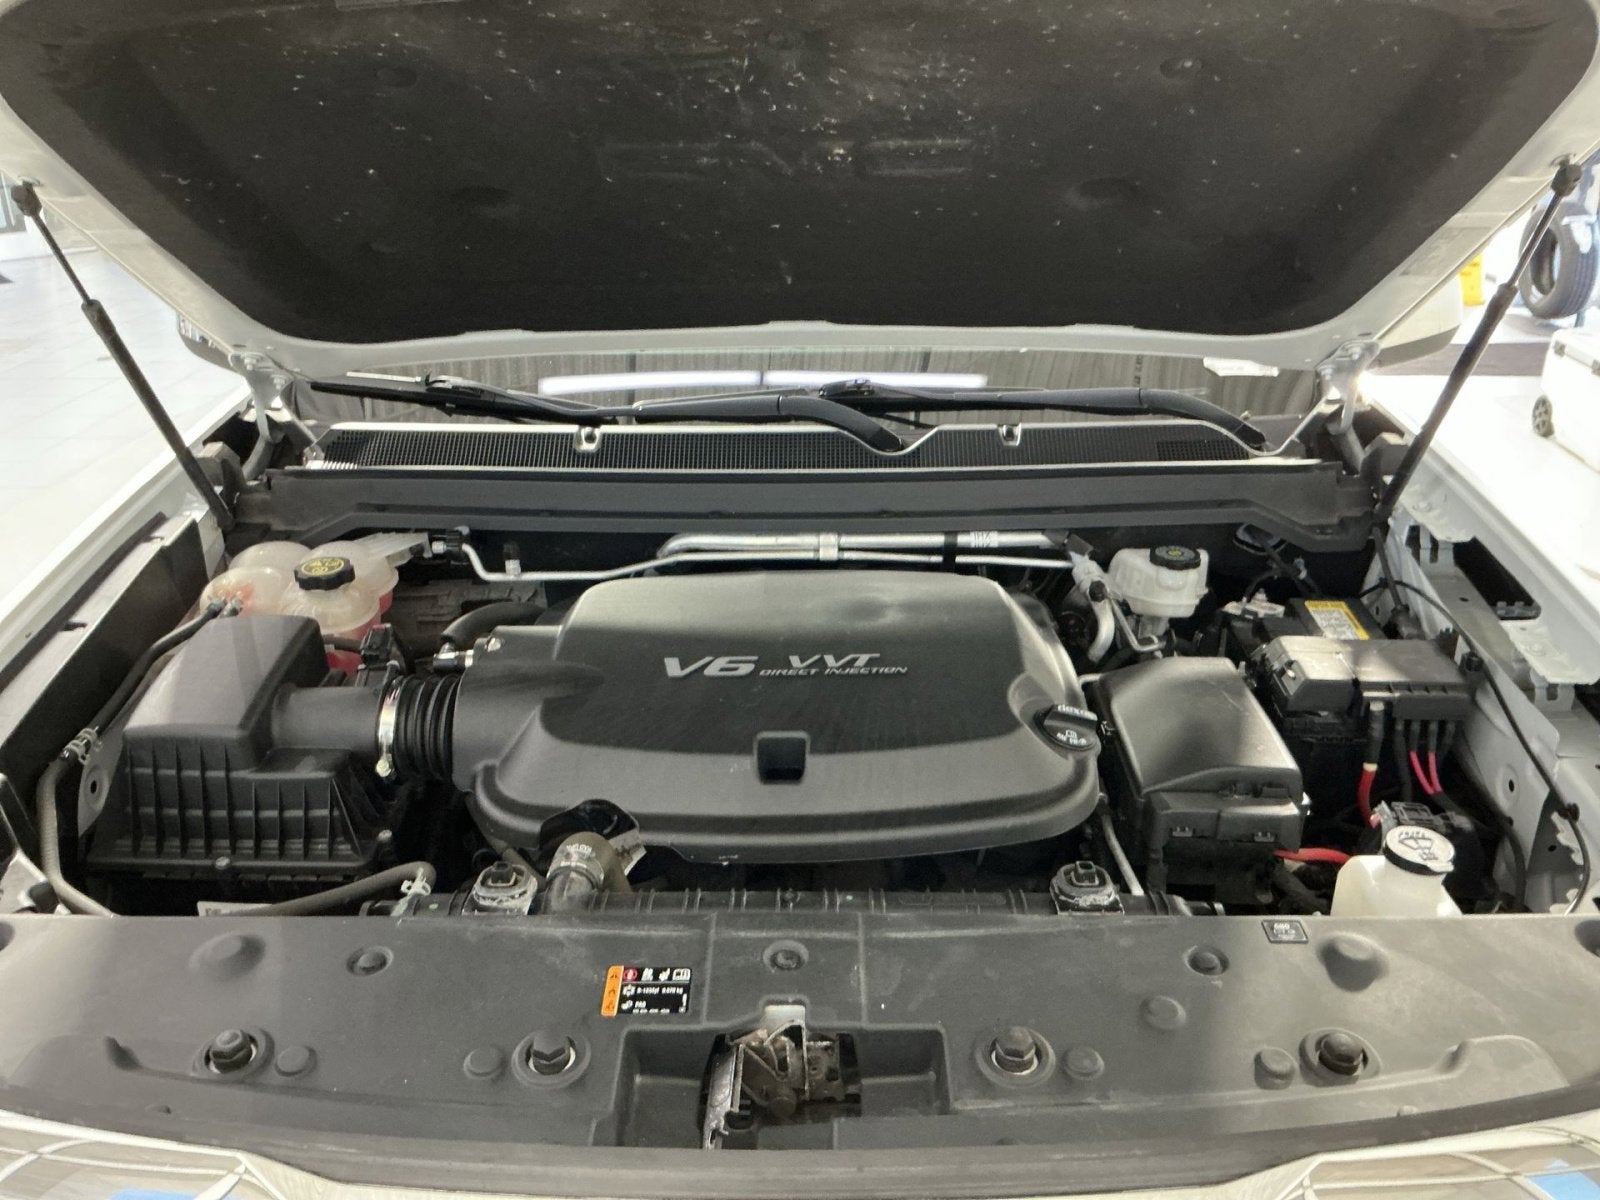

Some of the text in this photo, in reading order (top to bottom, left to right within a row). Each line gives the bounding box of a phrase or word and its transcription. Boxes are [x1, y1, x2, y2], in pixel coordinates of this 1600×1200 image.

[664, 655, 759, 678] V6
[789, 653, 880, 668] VVT
[759, 666, 908, 677] DIRECT INJECTION
